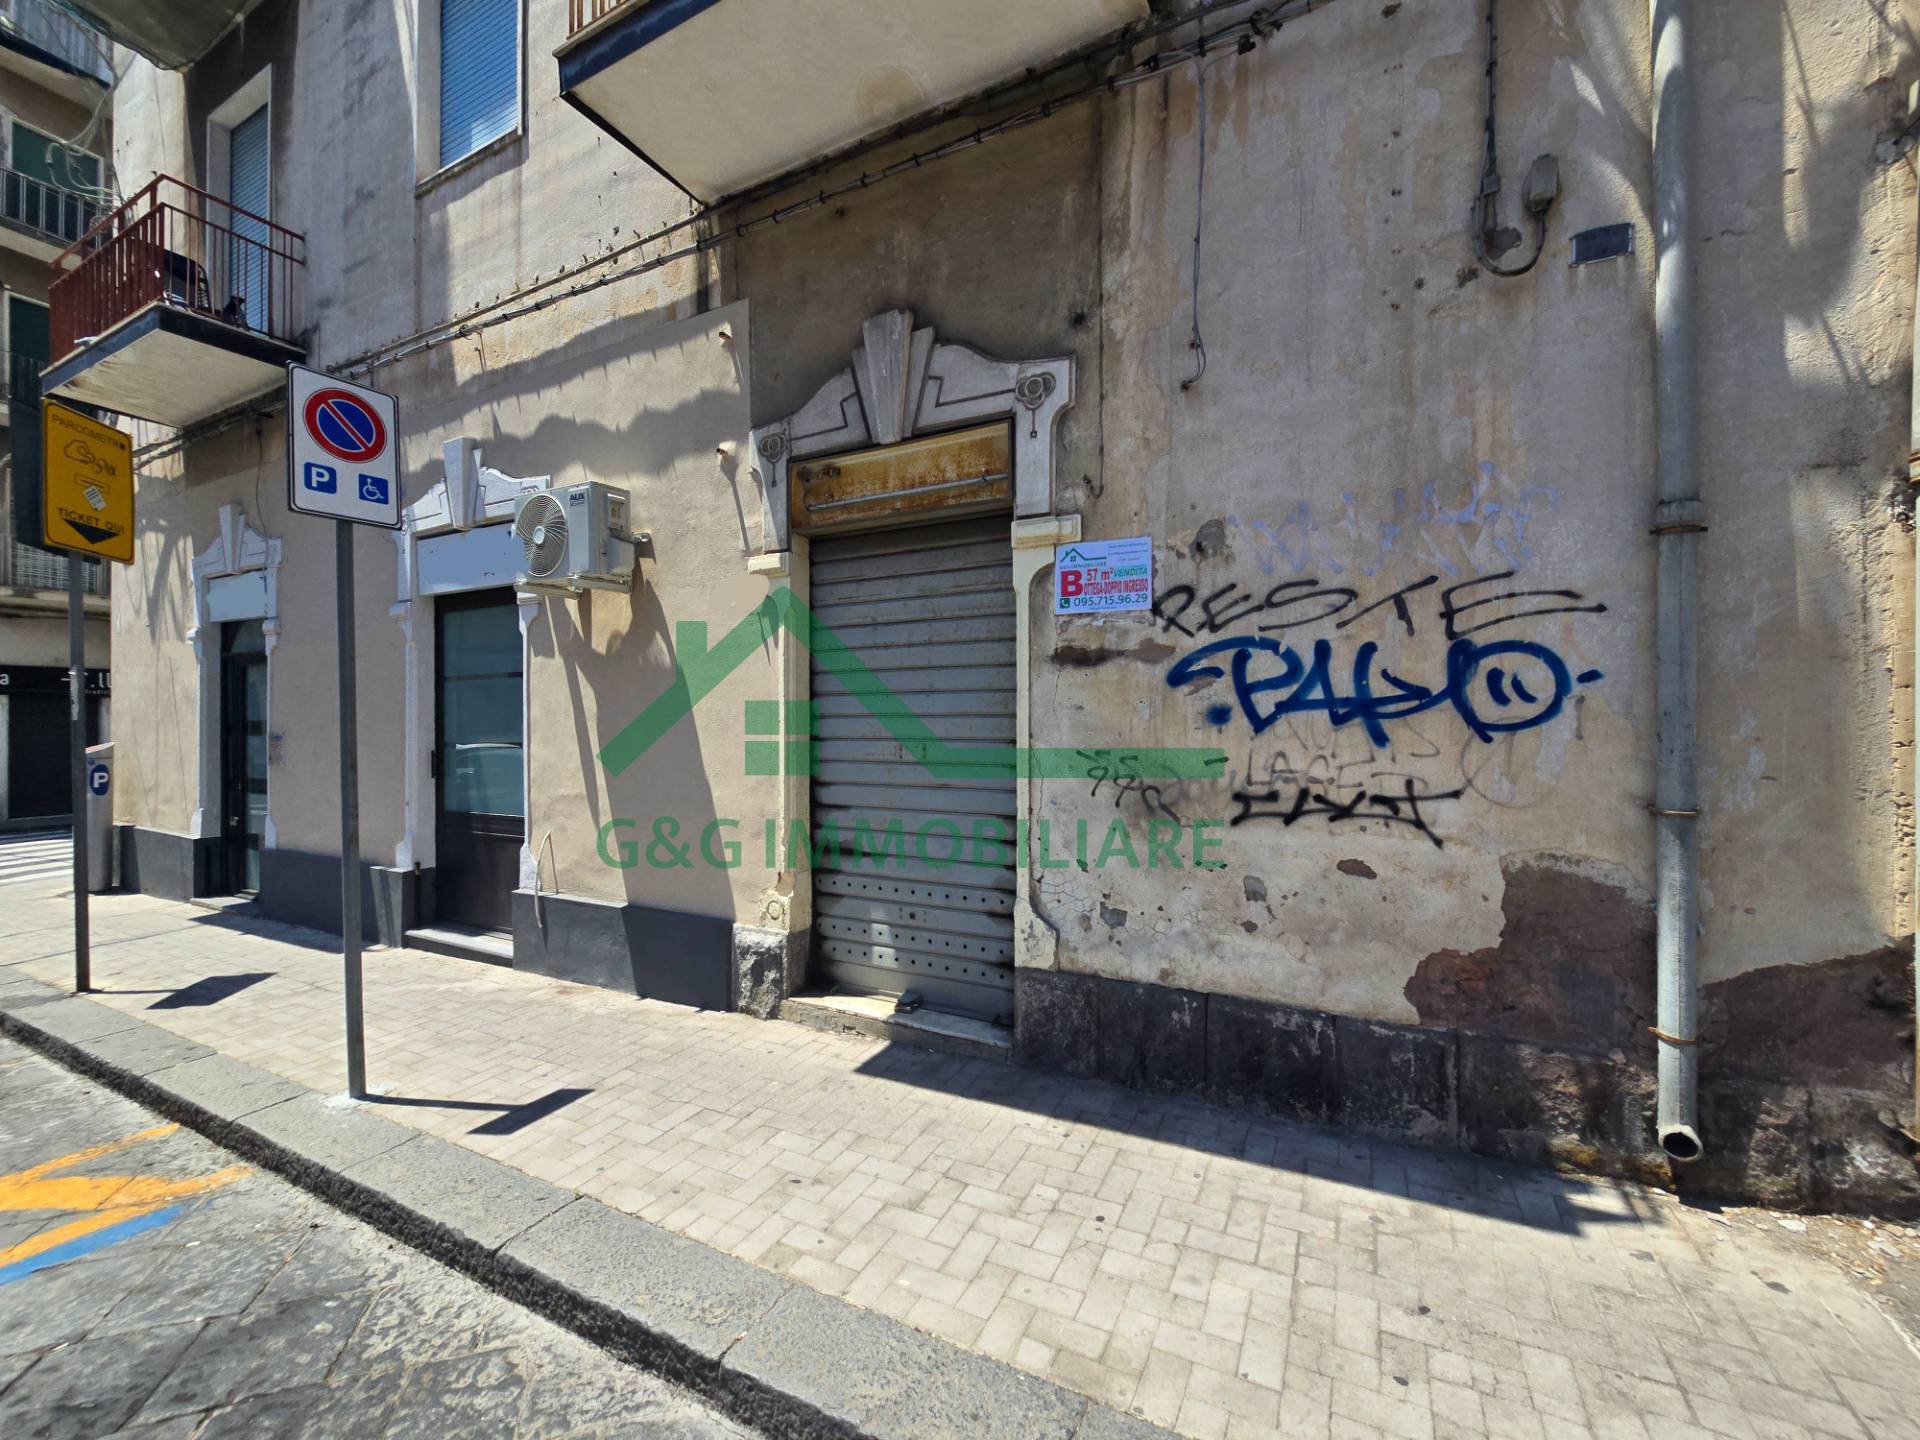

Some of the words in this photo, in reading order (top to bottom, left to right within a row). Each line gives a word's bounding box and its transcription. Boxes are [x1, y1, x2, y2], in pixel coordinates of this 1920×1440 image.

[311, 466, 330, 488] P
[569, 492, 586, 502] AUX
[57, 507, 100, 526] TICKET
[105, 521, 125, 536] QUI
[1087, 569, 1098, 581] 57
[1114, 567, 1148, 578] VENDITA
[1122, 579, 1148, 593] INGRESSO
[1073, 593, 1148, 607] 095.715.96.29
[93, 772, 108, 788] P
